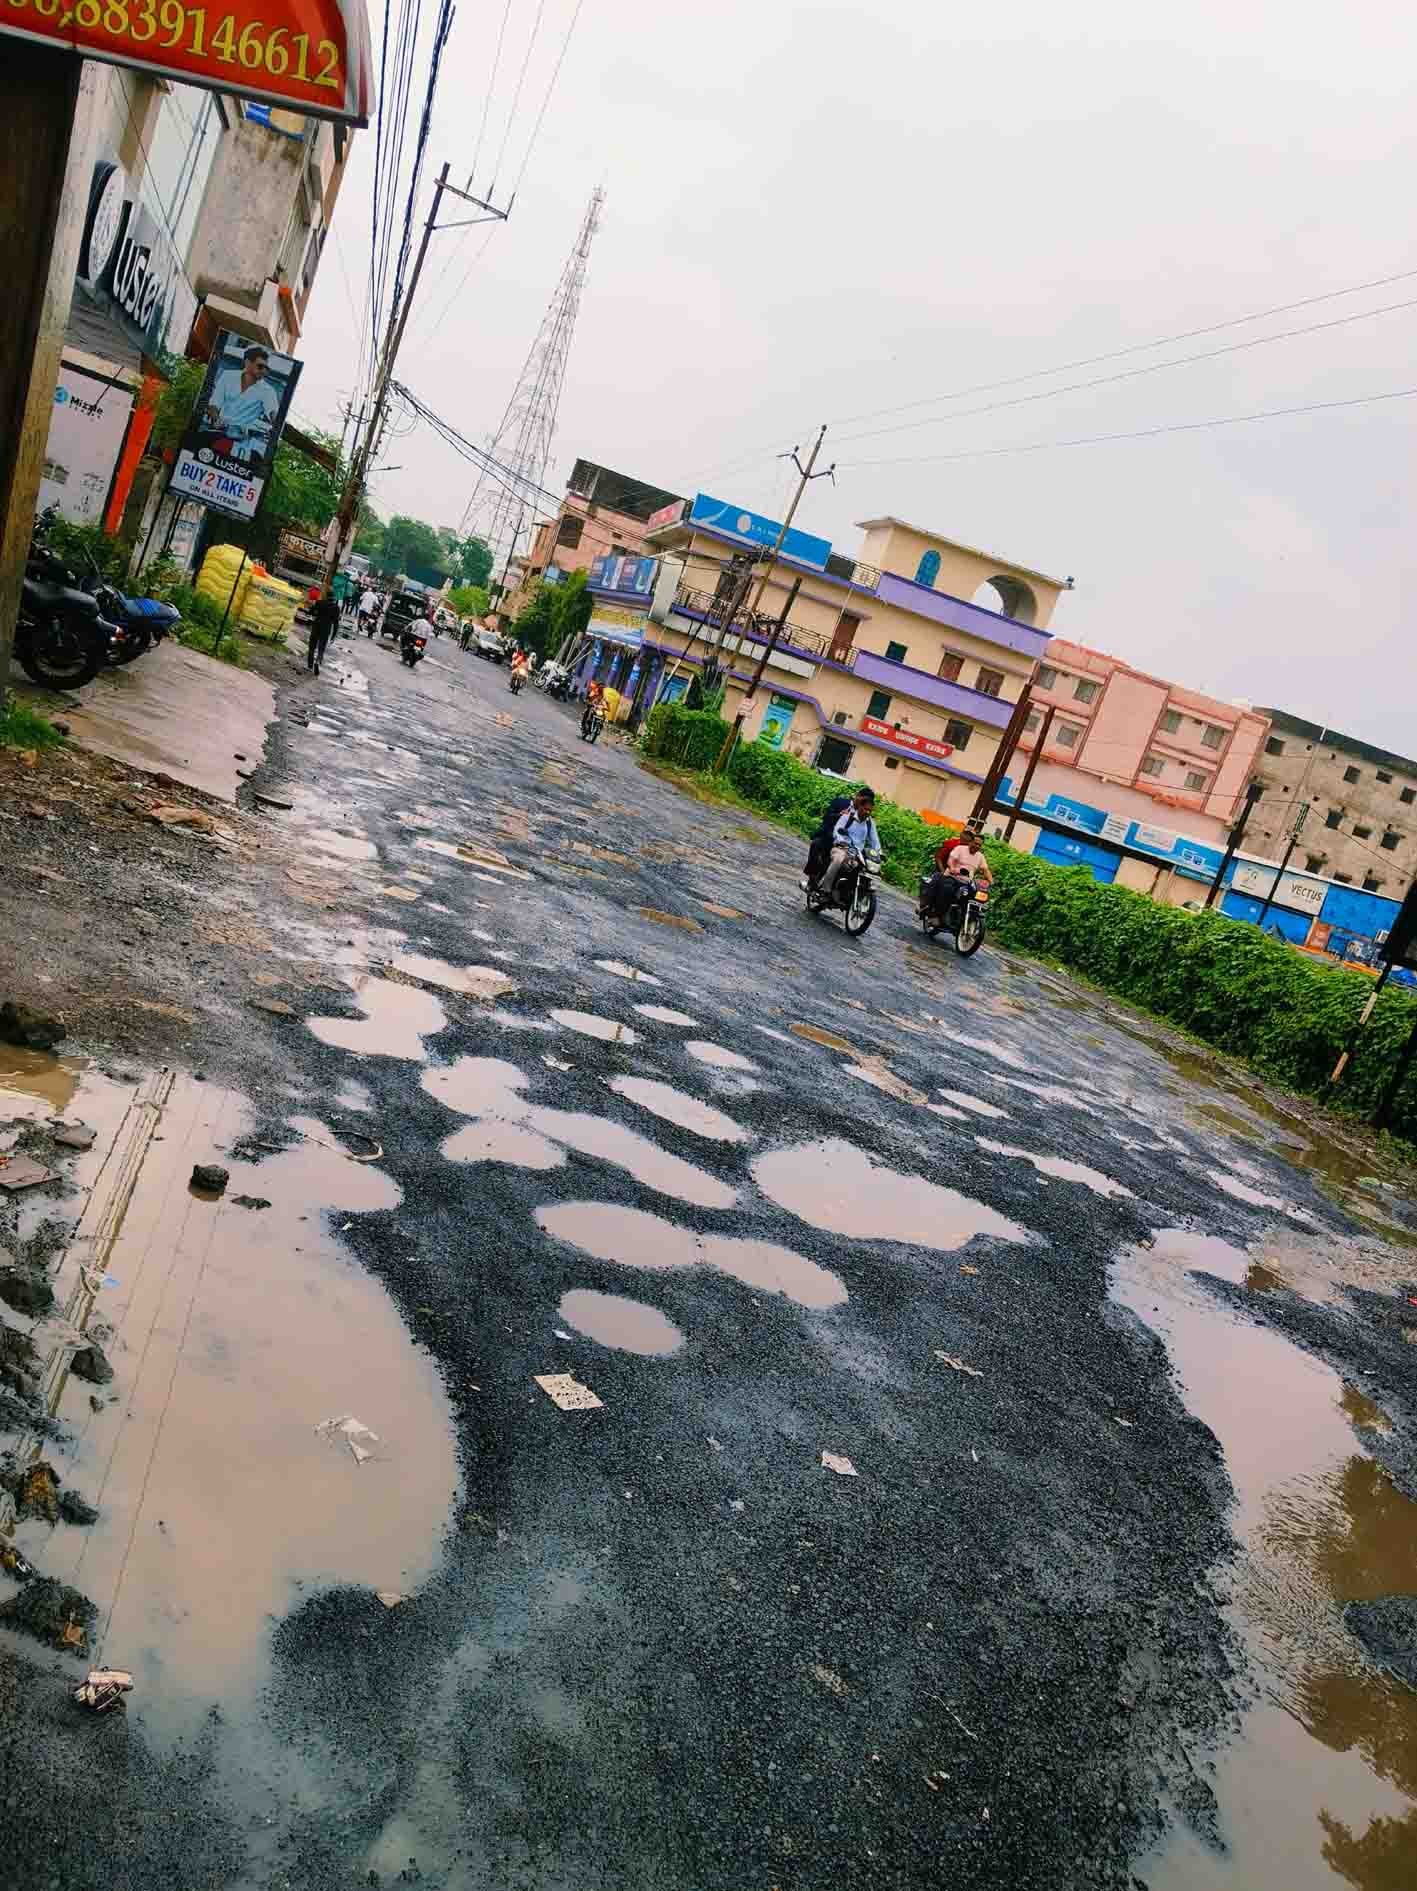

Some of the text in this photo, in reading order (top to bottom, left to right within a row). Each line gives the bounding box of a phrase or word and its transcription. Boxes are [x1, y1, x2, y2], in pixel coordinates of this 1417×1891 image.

[8, 0, 340, 88] ,8839146612
[181, 463, 256, 502] BUY 2 TAKE 5
[1291, 882, 1323, 901] VECTUS
